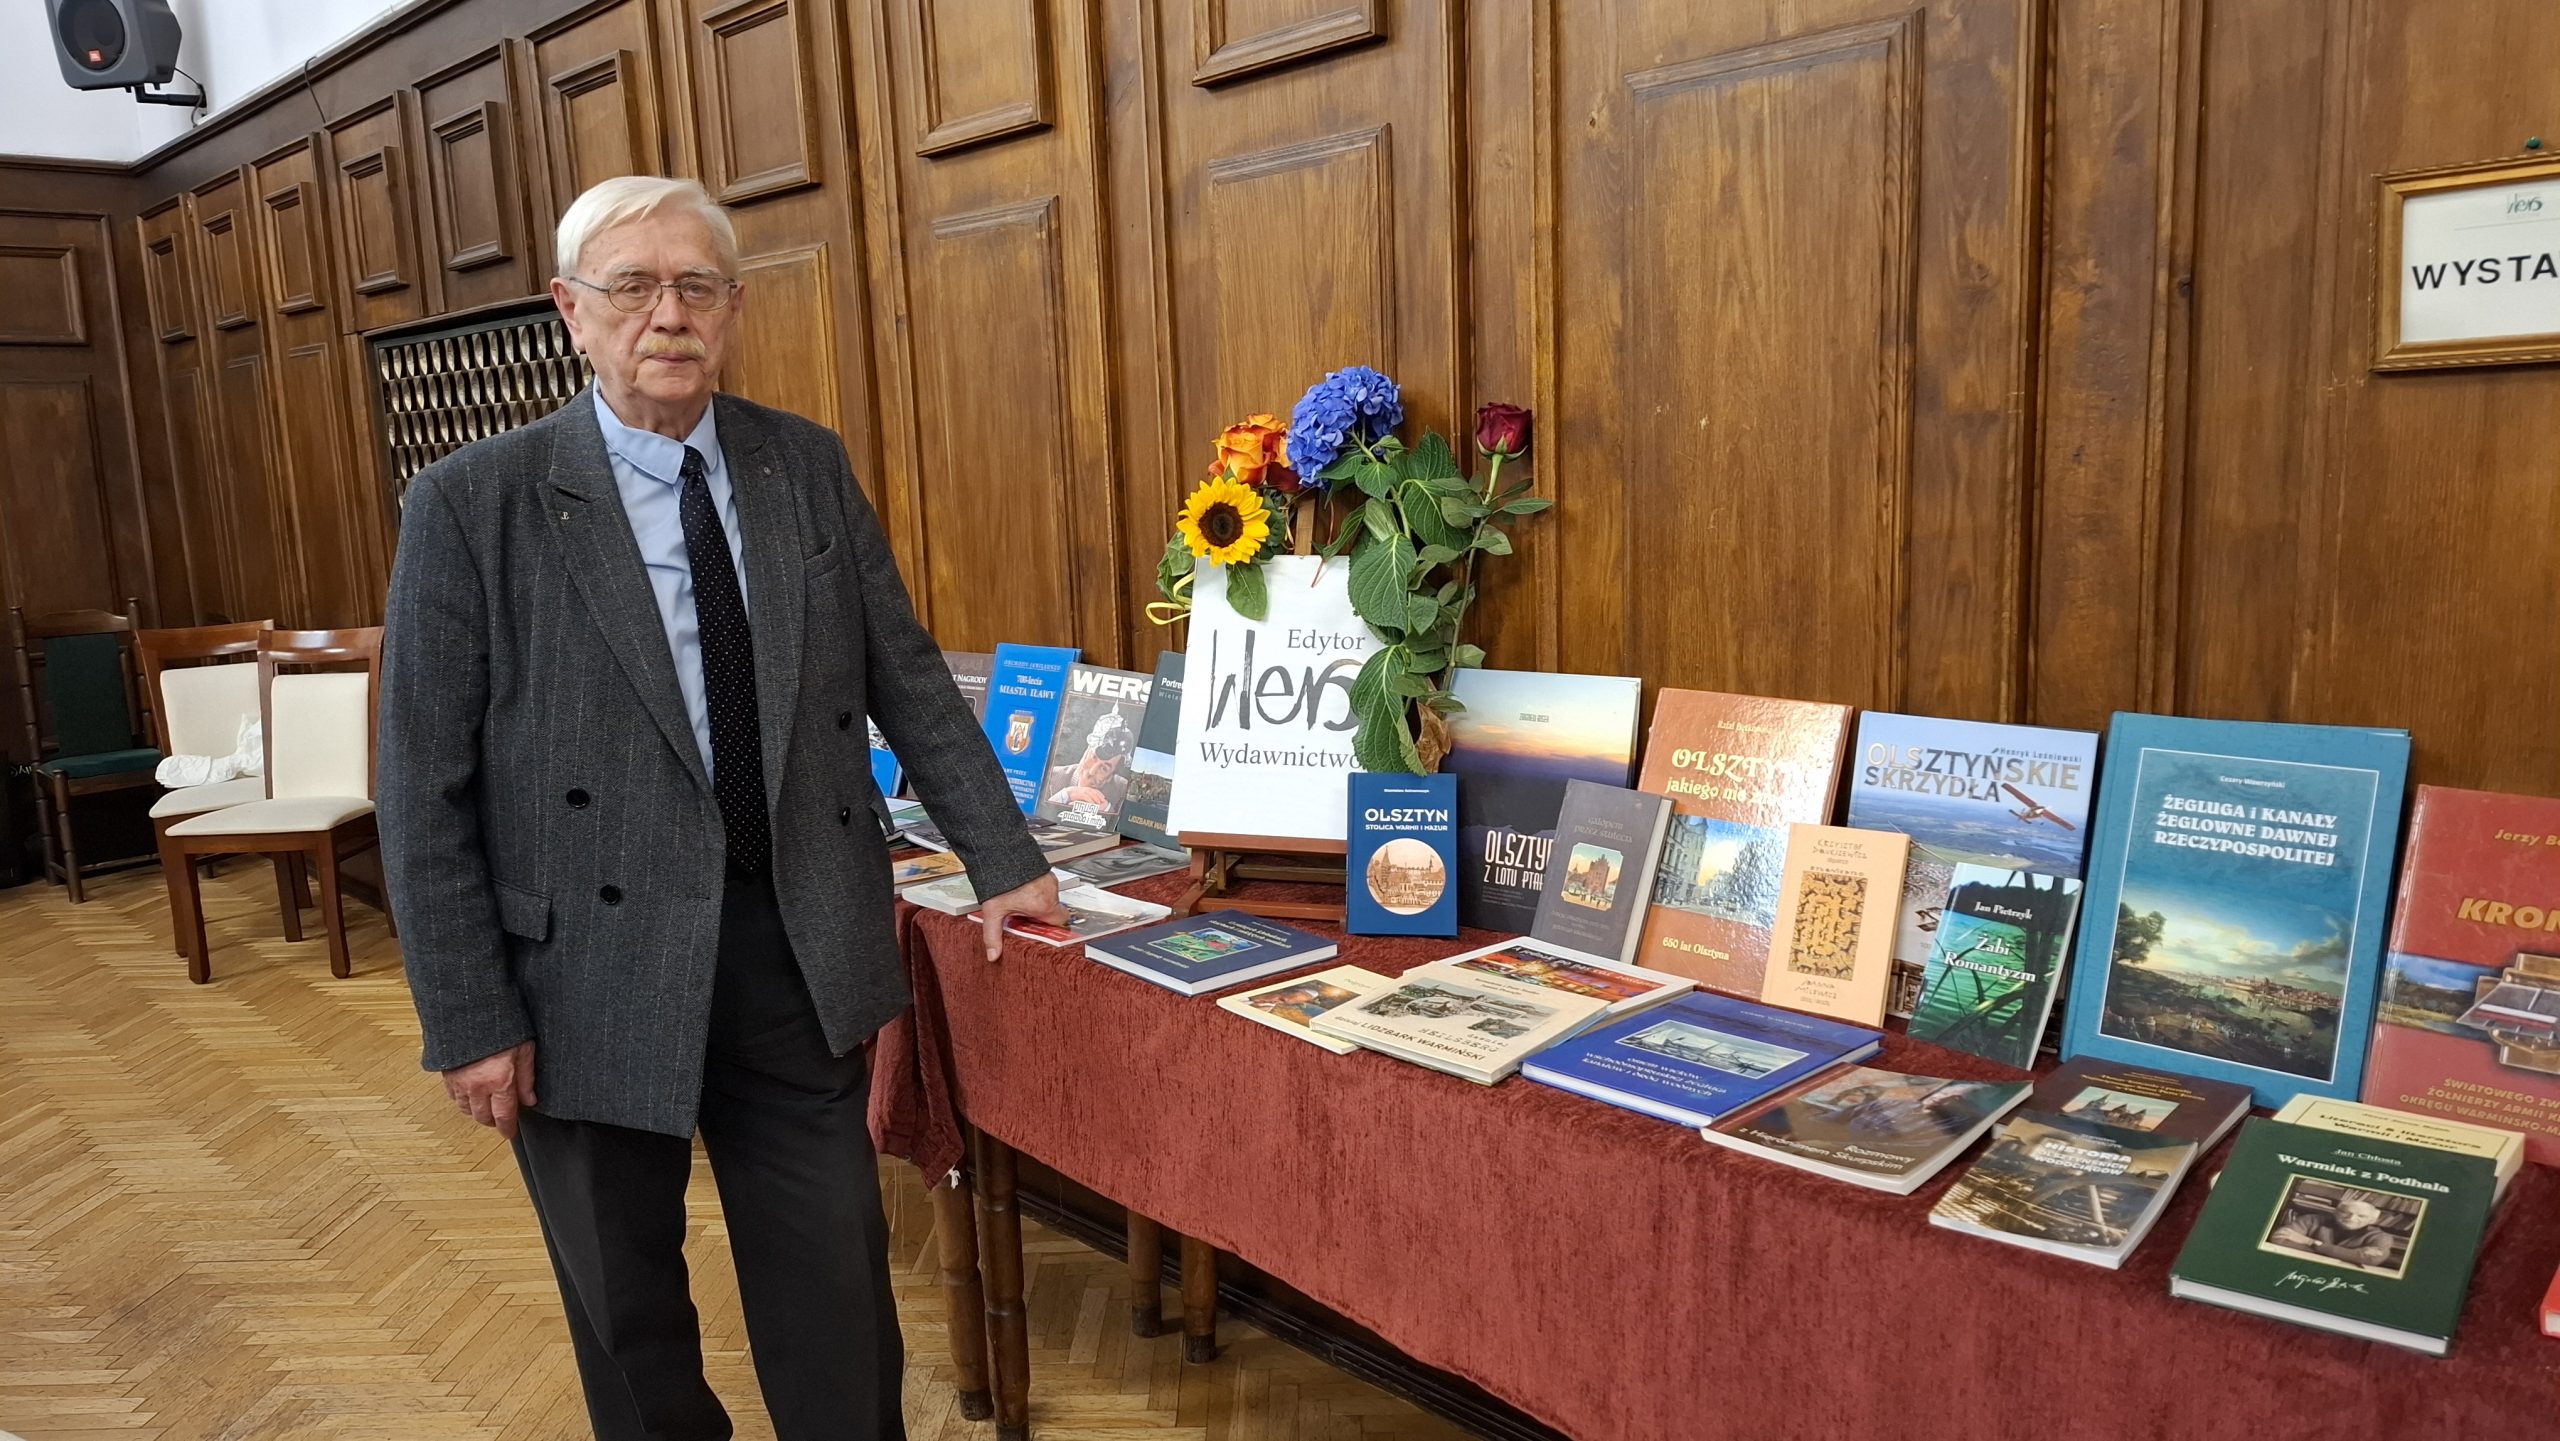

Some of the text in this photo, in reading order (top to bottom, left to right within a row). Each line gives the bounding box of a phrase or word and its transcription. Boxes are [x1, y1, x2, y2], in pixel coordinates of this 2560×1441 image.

[2411, 252, 2560, 290] WYSTA
[1287, 628, 1366, 656] Edytor
[999, 685, 1027, 696] MIASTA
[1029, 688, 1056, 700] IŁAWY
[1199, 741, 1363, 769] Wydawnictwo
[1671, 748, 1784, 783] OLSZTY
[1867, 742, 2081, 791] OLSZTYŃSKIE
[1665, 776, 1720, 801] jakiego
[1864, 765, 2001, 802] SKRZYDŁA
[1364, 808, 1448, 823] OLSZTYN
[2162, 794, 2246, 819] ŻEGLUGA
[2261, 807, 2338, 830] KANAŁY
[1424, 824, 1448, 832] MAZUR
[2156, 811, 2338, 848] ŻEGLOWNE DAWNEJ
[2494, 829, 2541, 847] Jerzy
[2154, 830, 2335, 867] RZECZYPOSPOLITEJ
[1483, 864, 1490, 883] Z
[1495, 866, 1518, 886] LOTU
[1974, 901, 2033, 921] Jan Pietrzyk
[1662, 937, 1730, 961] 650 lat Olsztyna
[1974, 933, 2011, 957] Żabi
[1943, 951, 2036, 983] Romantyzm
[1361, 1022, 1417, 1044] LIDZBARK
[1417, 1038, 1487, 1061] WARMIŃSKI
[2400, 1093, 2454, 1113] OKRĘGU
[2426, 1085, 2501, 1110] ŻOŁNIERZY
[2503, 1103, 2545, 1118] ARMII
[2443, 1077, 2535, 1104] ŚWIATOWEGO
[1843, 1145, 1916, 1164] Rozmowy
[2044, 1142, 2132, 1164] HISTORIA
[2334, 1148, 2355, 1158] Jan
[2276, 1153, 2450, 1194] Warmiak z Podhala
